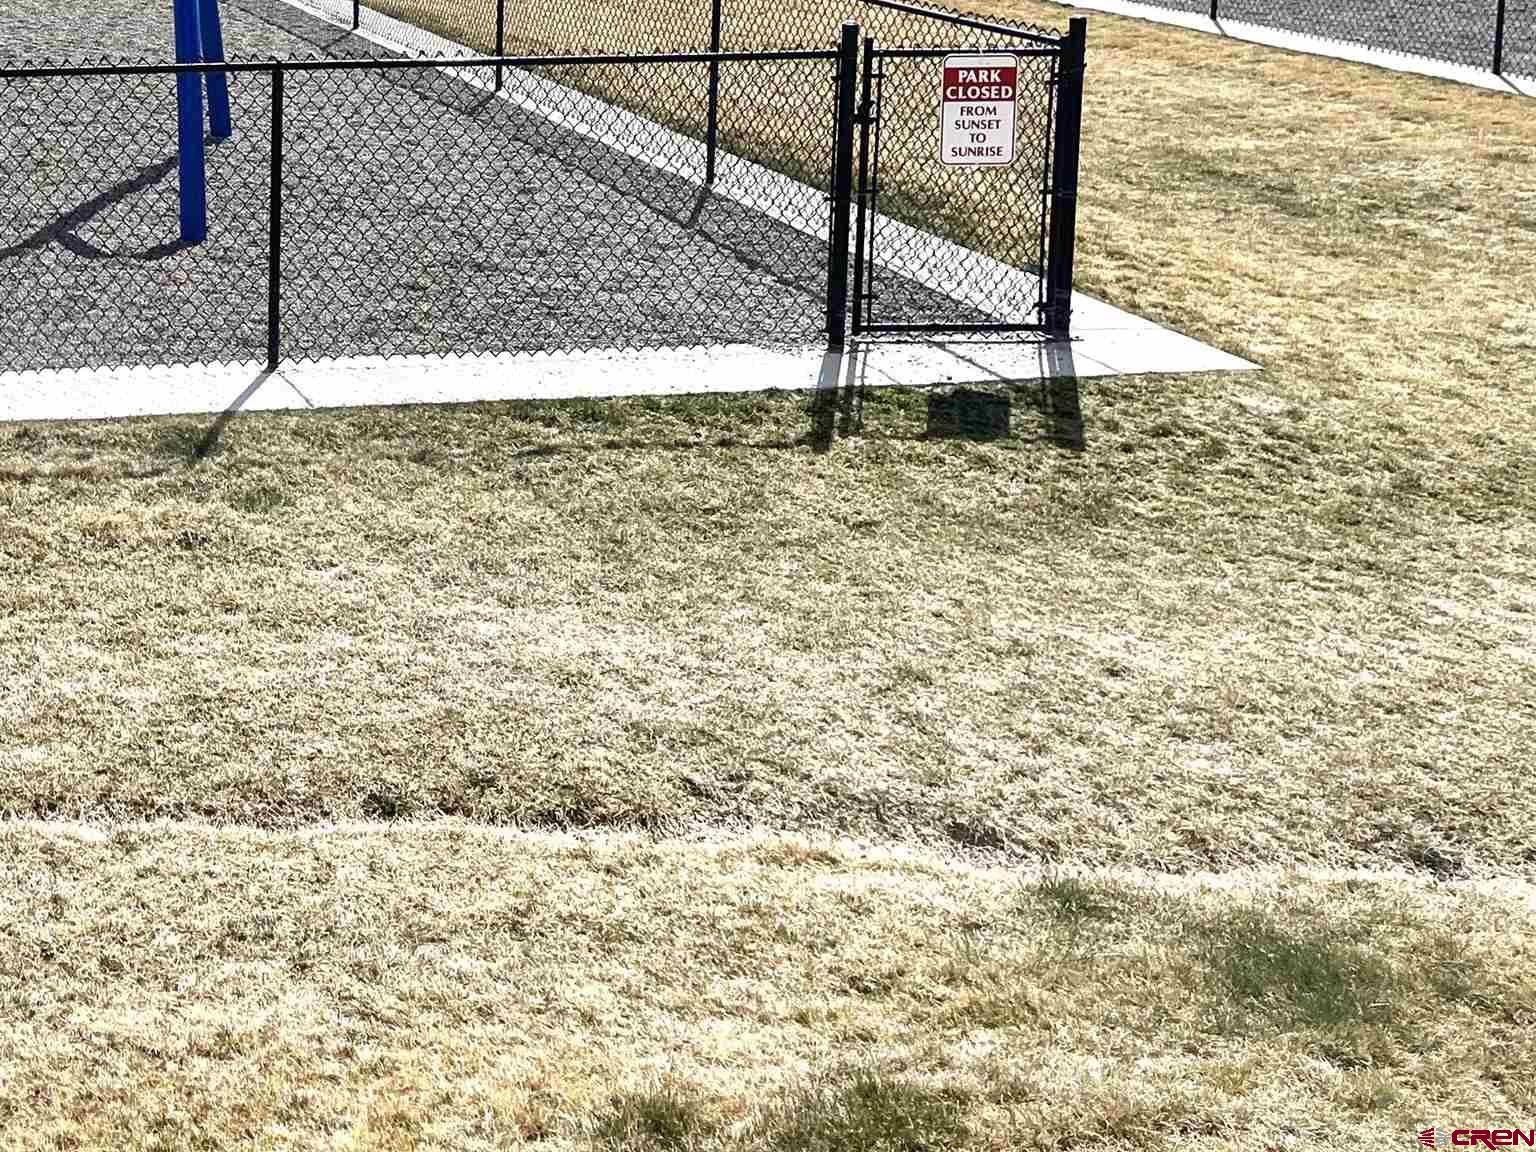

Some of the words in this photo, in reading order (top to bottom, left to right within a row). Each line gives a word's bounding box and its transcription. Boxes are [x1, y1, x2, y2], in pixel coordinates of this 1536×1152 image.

[958, 69, 1002, 83] PARK
[945, 86, 1013, 99] CLOSED
[960, 106, 997, 116] FROM
[954, 119, 1002, 130] SUNSET
[969, 133, 986, 143] TO
[951, 146, 1003, 157] SUNRISE
